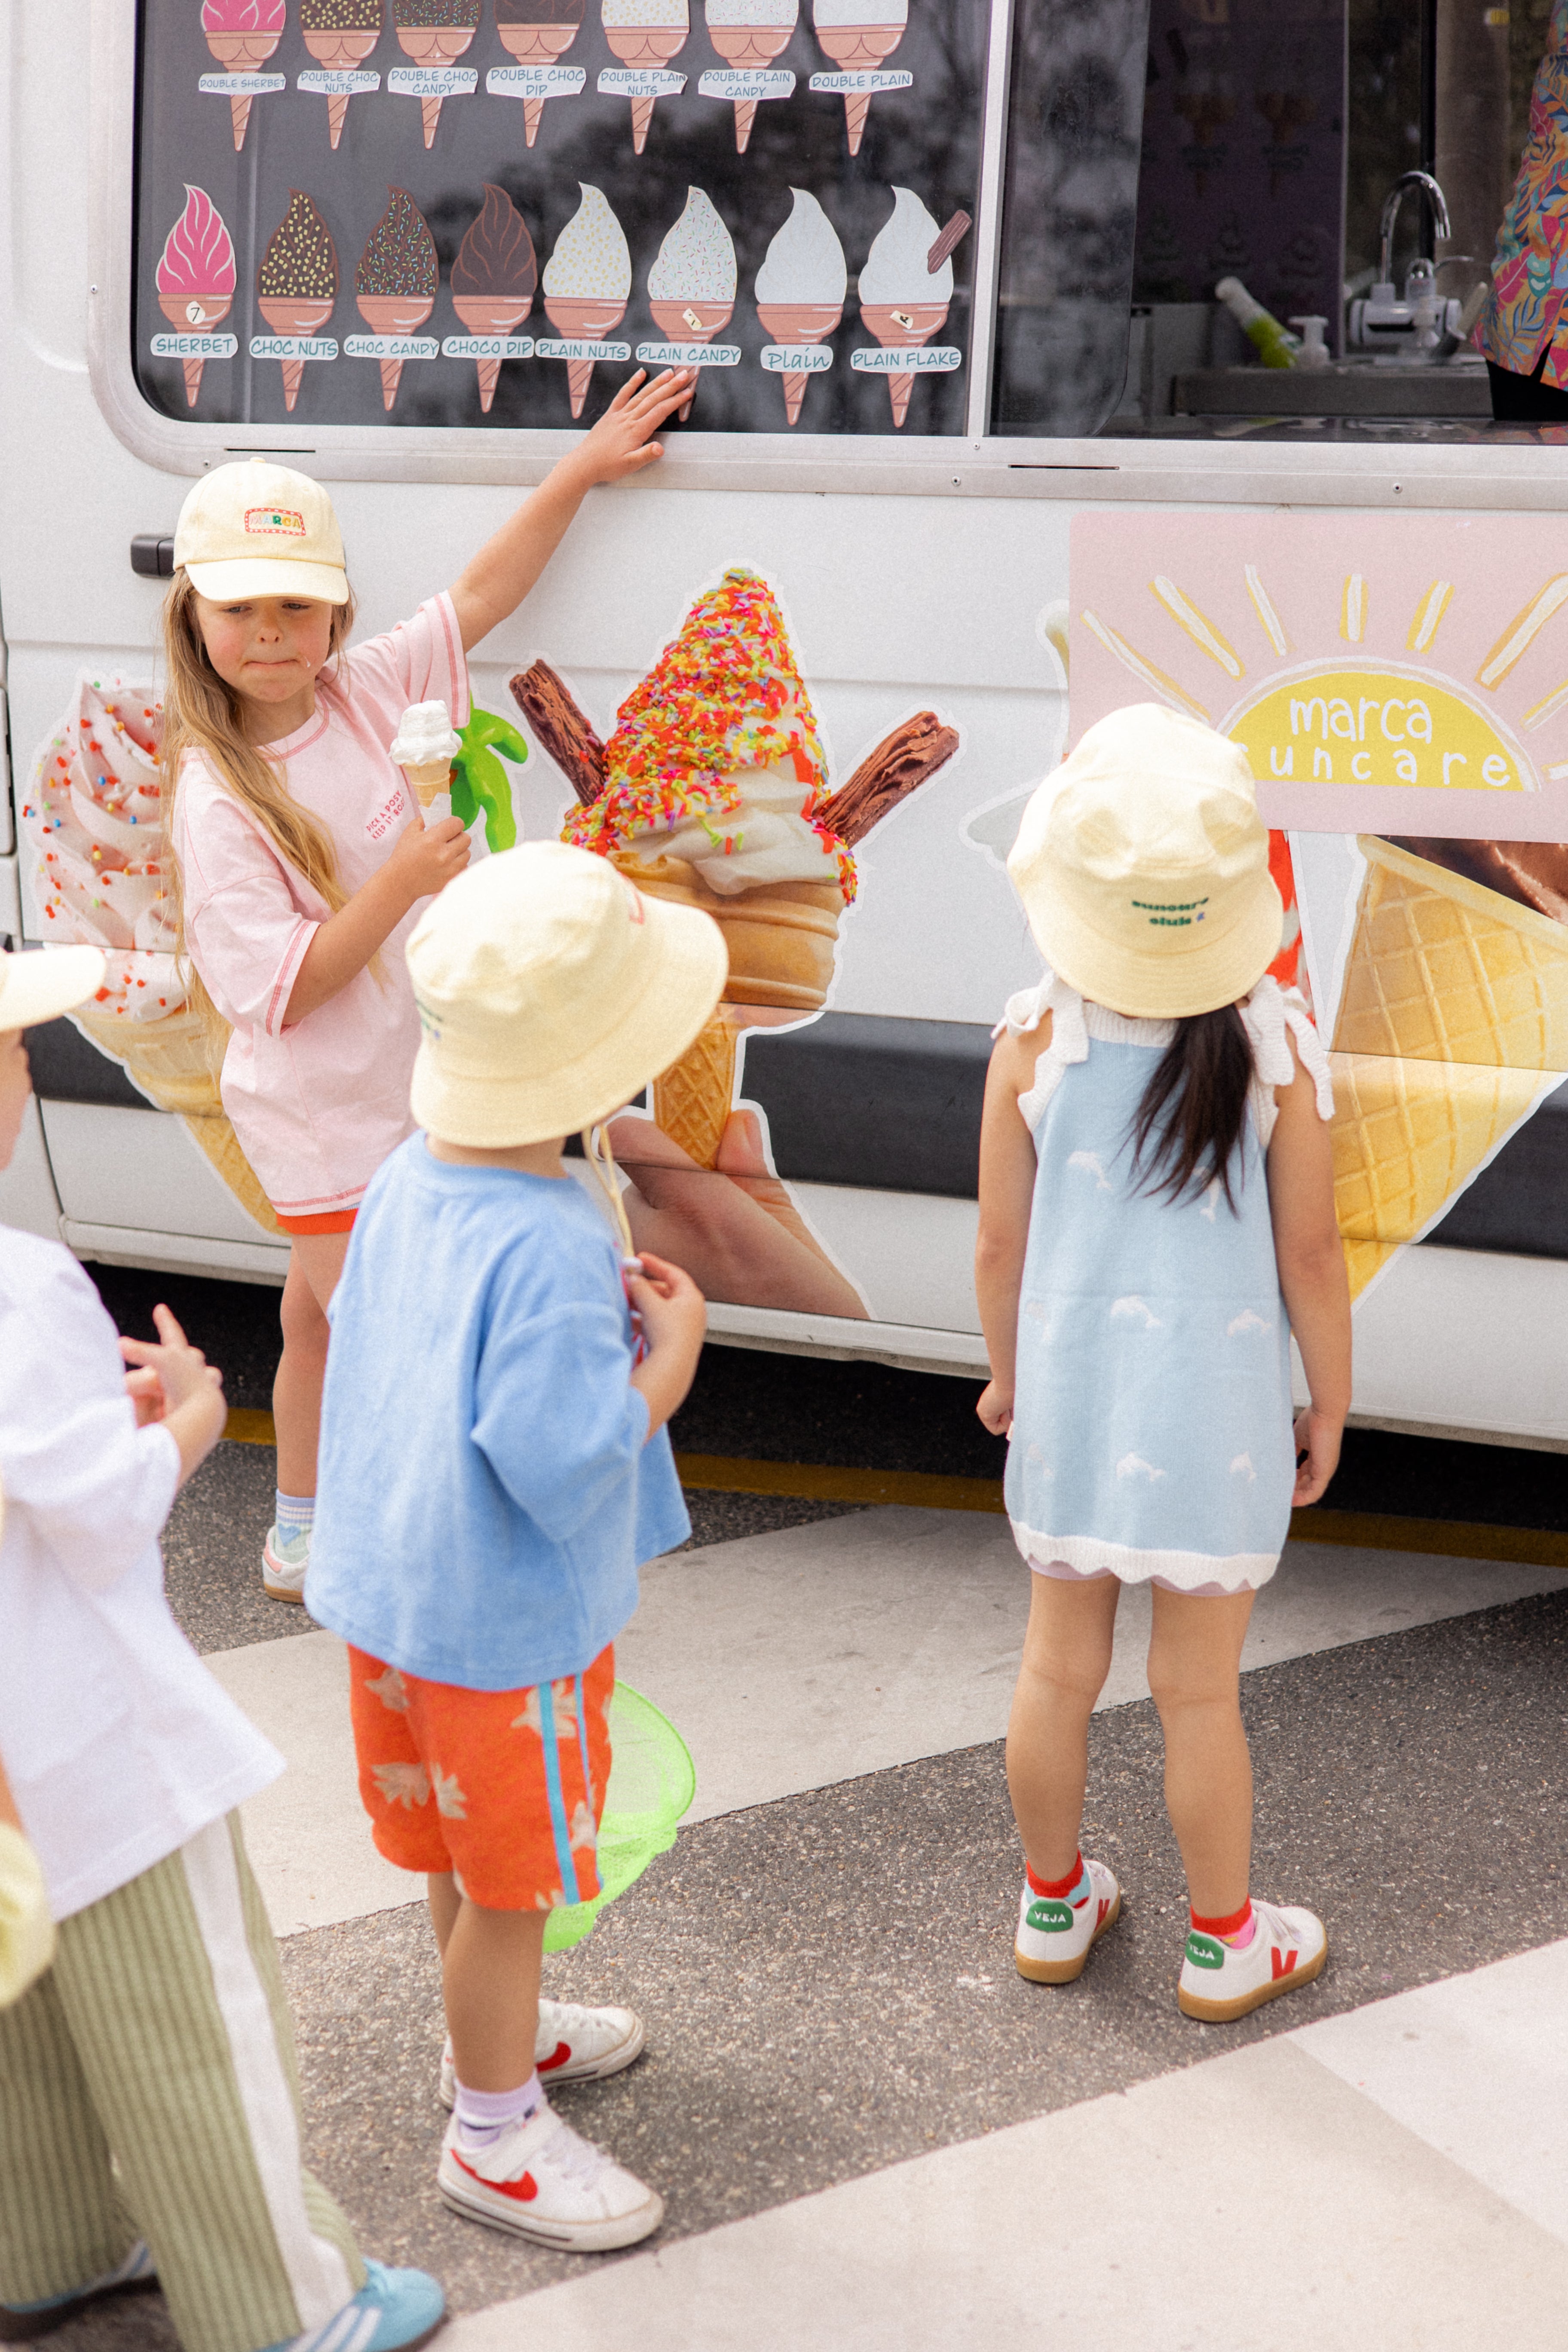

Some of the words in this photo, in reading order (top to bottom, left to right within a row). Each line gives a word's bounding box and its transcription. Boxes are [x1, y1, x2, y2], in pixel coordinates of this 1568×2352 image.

[301, 72, 344, 82] DOUBLE
[347, 72, 378, 82] CHOC
[391, 70, 439, 81] DOUBLE
[444, 71, 478, 82] CHOC
[491, 69, 543, 81] DOUBLE
[548, 69, 585, 82] CHOC
[601, 71, 647, 82] DOUBLE
[652, 72, 686, 82] PLAIN
[704, 71, 750, 82] DOUBLE
[756, 72, 790, 82] PLAIN
[812, 75, 865, 87] DOUBLE
[871, 74, 910, 86] PLAIN
[200, 79, 237, 88] DOUBLE
[241, 79, 286, 88] SHERBET
[325, 83, 352, 92] NUTS
[412, 83, 455, 94] CANDY
[628, 85, 658, 95] NUTS
[526, 85, 548, 96] DIP
[725, 86, 767, 97] CANDY
[156, 338, 233, 352] SHERBET
[251, 339, 294, 355] CHOC
[298, 340, 338, 356] NUTS
[346, 340, 385, 354] CHOC
[390, 341, 439, 355] CANDY
[447, 340, 500, 354] CHOCO
[507, 341, 532, 355] DIP
[539, 343, 582, 357] PLAIN
[588, 345, 627, 358] NUTS
[638, 347, 681, 361] PLAIN
[687, 348, 741, 362] CANDY
[767, 347, 830, 369] Plain
[853, 353, 900, 367] PLAIN
[906, 352, 960, 366] FLAKE
[249, 514, 300, 528] MARCA
[1289, 696, 1433, 744] marca
[1237, 742, 1511, 787] uncare
[366, 818, 381, 832] PICK
[385, 790, 401, 812] POSY
[371, 825, 386, 840] KEEP
[386, 816, 394, 824] IT
[1034, 1910, 1066, 1923] VEJA
